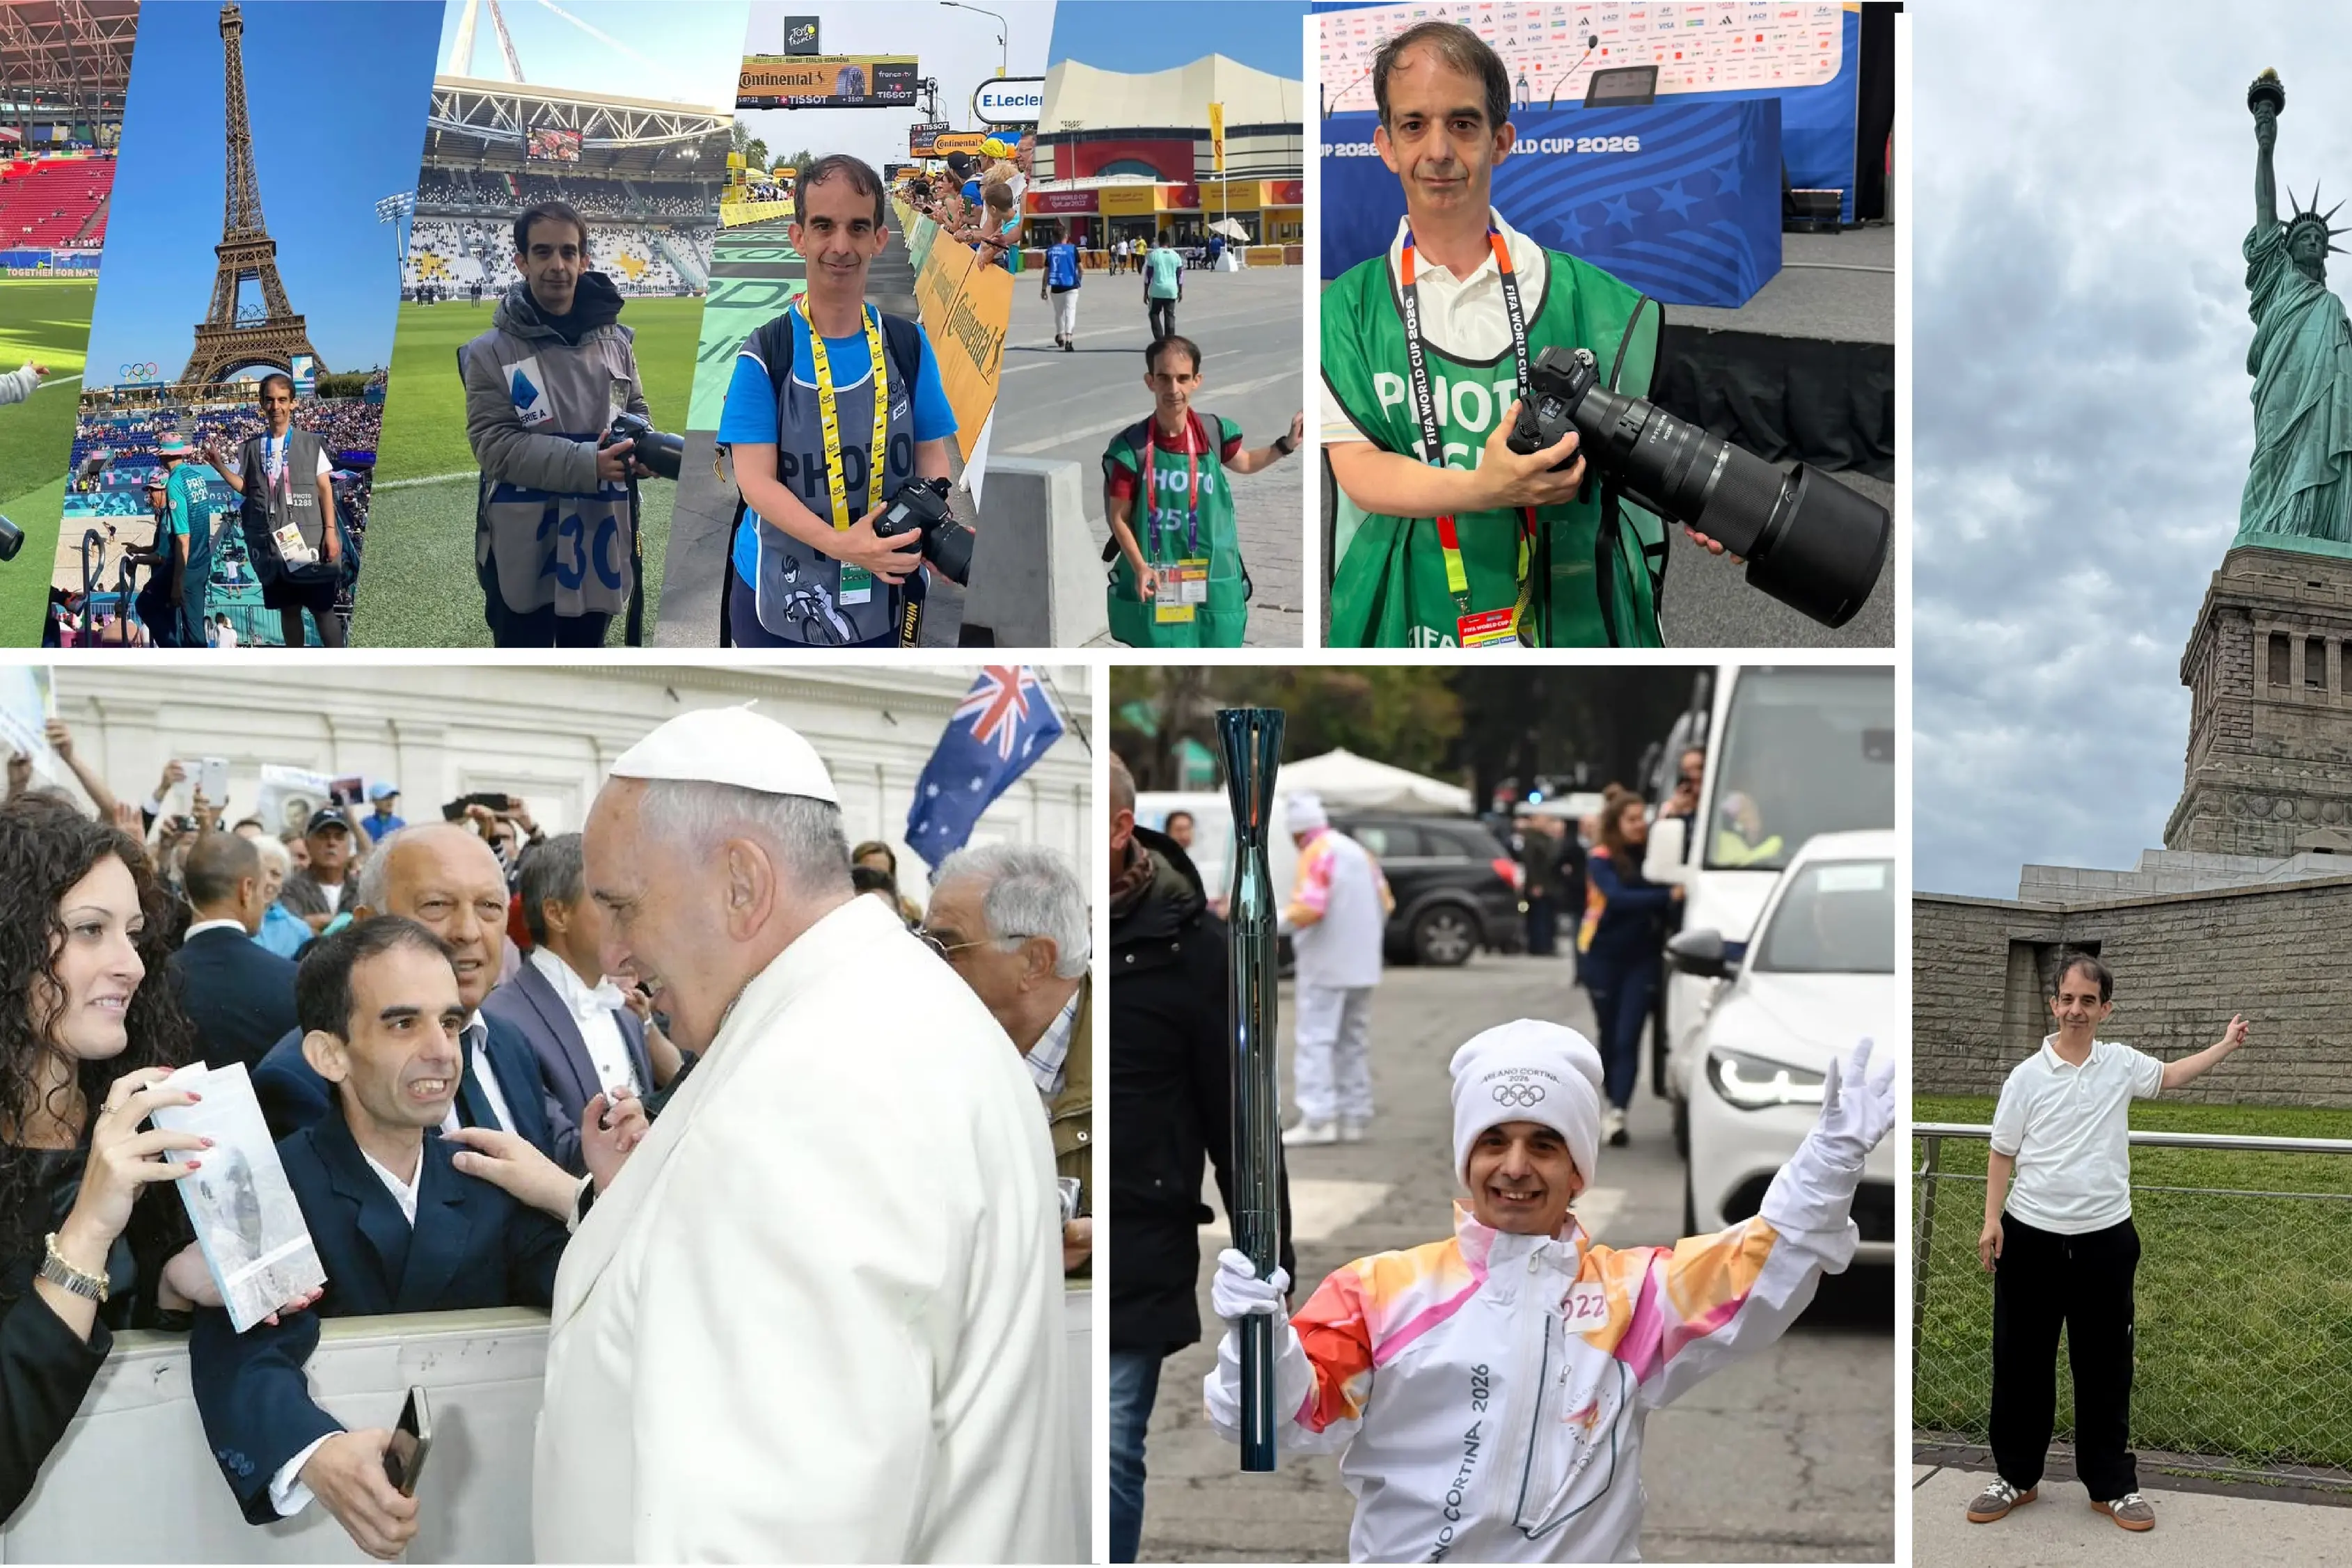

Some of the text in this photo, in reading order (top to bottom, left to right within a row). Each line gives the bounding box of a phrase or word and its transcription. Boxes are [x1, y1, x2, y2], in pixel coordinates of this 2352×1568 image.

[739, 72, 812, 88] Continental
[789, 95, 828, 104] TISSOT
[937, 140, 977, 149] Continental
[1540, 138, 1572, 154] CUP
[1577, 136, 1641, 152] 2026
[1505, 285, 1519, 311] FIFA
[1511, 312, 1526, 357] WORLD
[1405, 297, 1437, 445] FIFA WORLD CUP 2026
[1518, 359, 1527, 384] CUP
[539, 409, 546, 418] A
[903, 601, 919, 639] Nikon
[1476, 622, 1497, 631] WORLD
[1444, 1420, 1483, 1522] CORTINA
[1471, 1363, 1490, 1413] 2026
